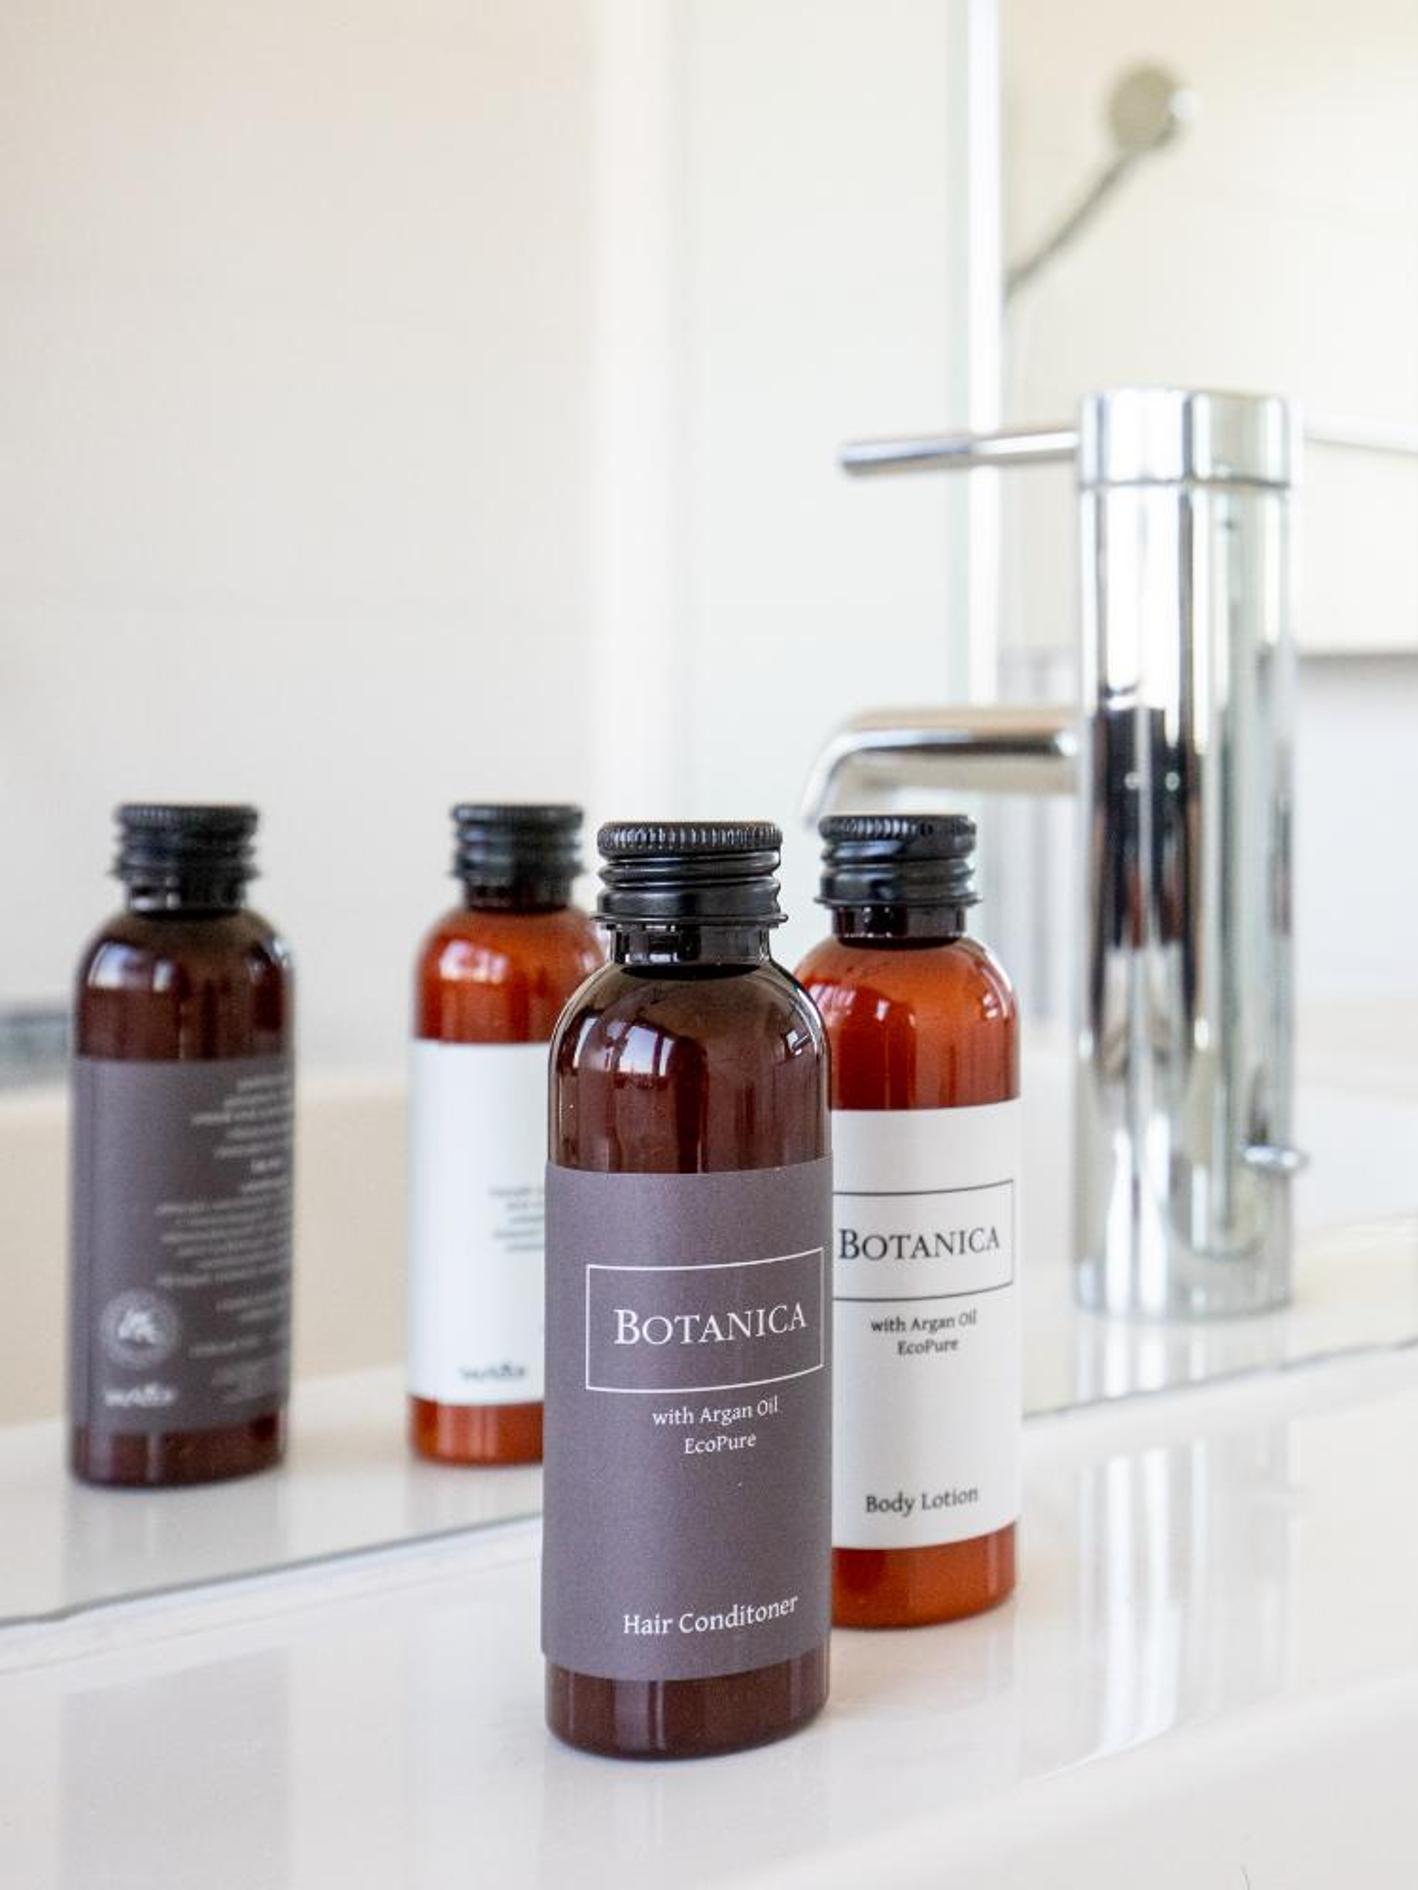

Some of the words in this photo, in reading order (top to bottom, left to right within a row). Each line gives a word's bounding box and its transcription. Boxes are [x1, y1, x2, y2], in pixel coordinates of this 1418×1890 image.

[838, 1226, 1001, 1262] BOTANICA
[614, 1303, 807, 1345] BOTANICA
[870, 1318, 906, 1333] with
[910, 1315, 958, 1334] Argan
[961, 1308, 978, 1327] Oil
[896, 1340, 959, 1356] EcoPure
[652, 1407, 694, 1426] with
[700, 1404, 753, 1426] Argan
[757, 1396, 779, 1418] Oil
[684, 1431, 757, 1455] EcoPure
[865, 1492, 915, 1516] Body
[921, 1486, 980, 1510] Lotion
[622, 1613, 673, 1635] Hair
[678, 1595, 799, 1633] Conditoner
